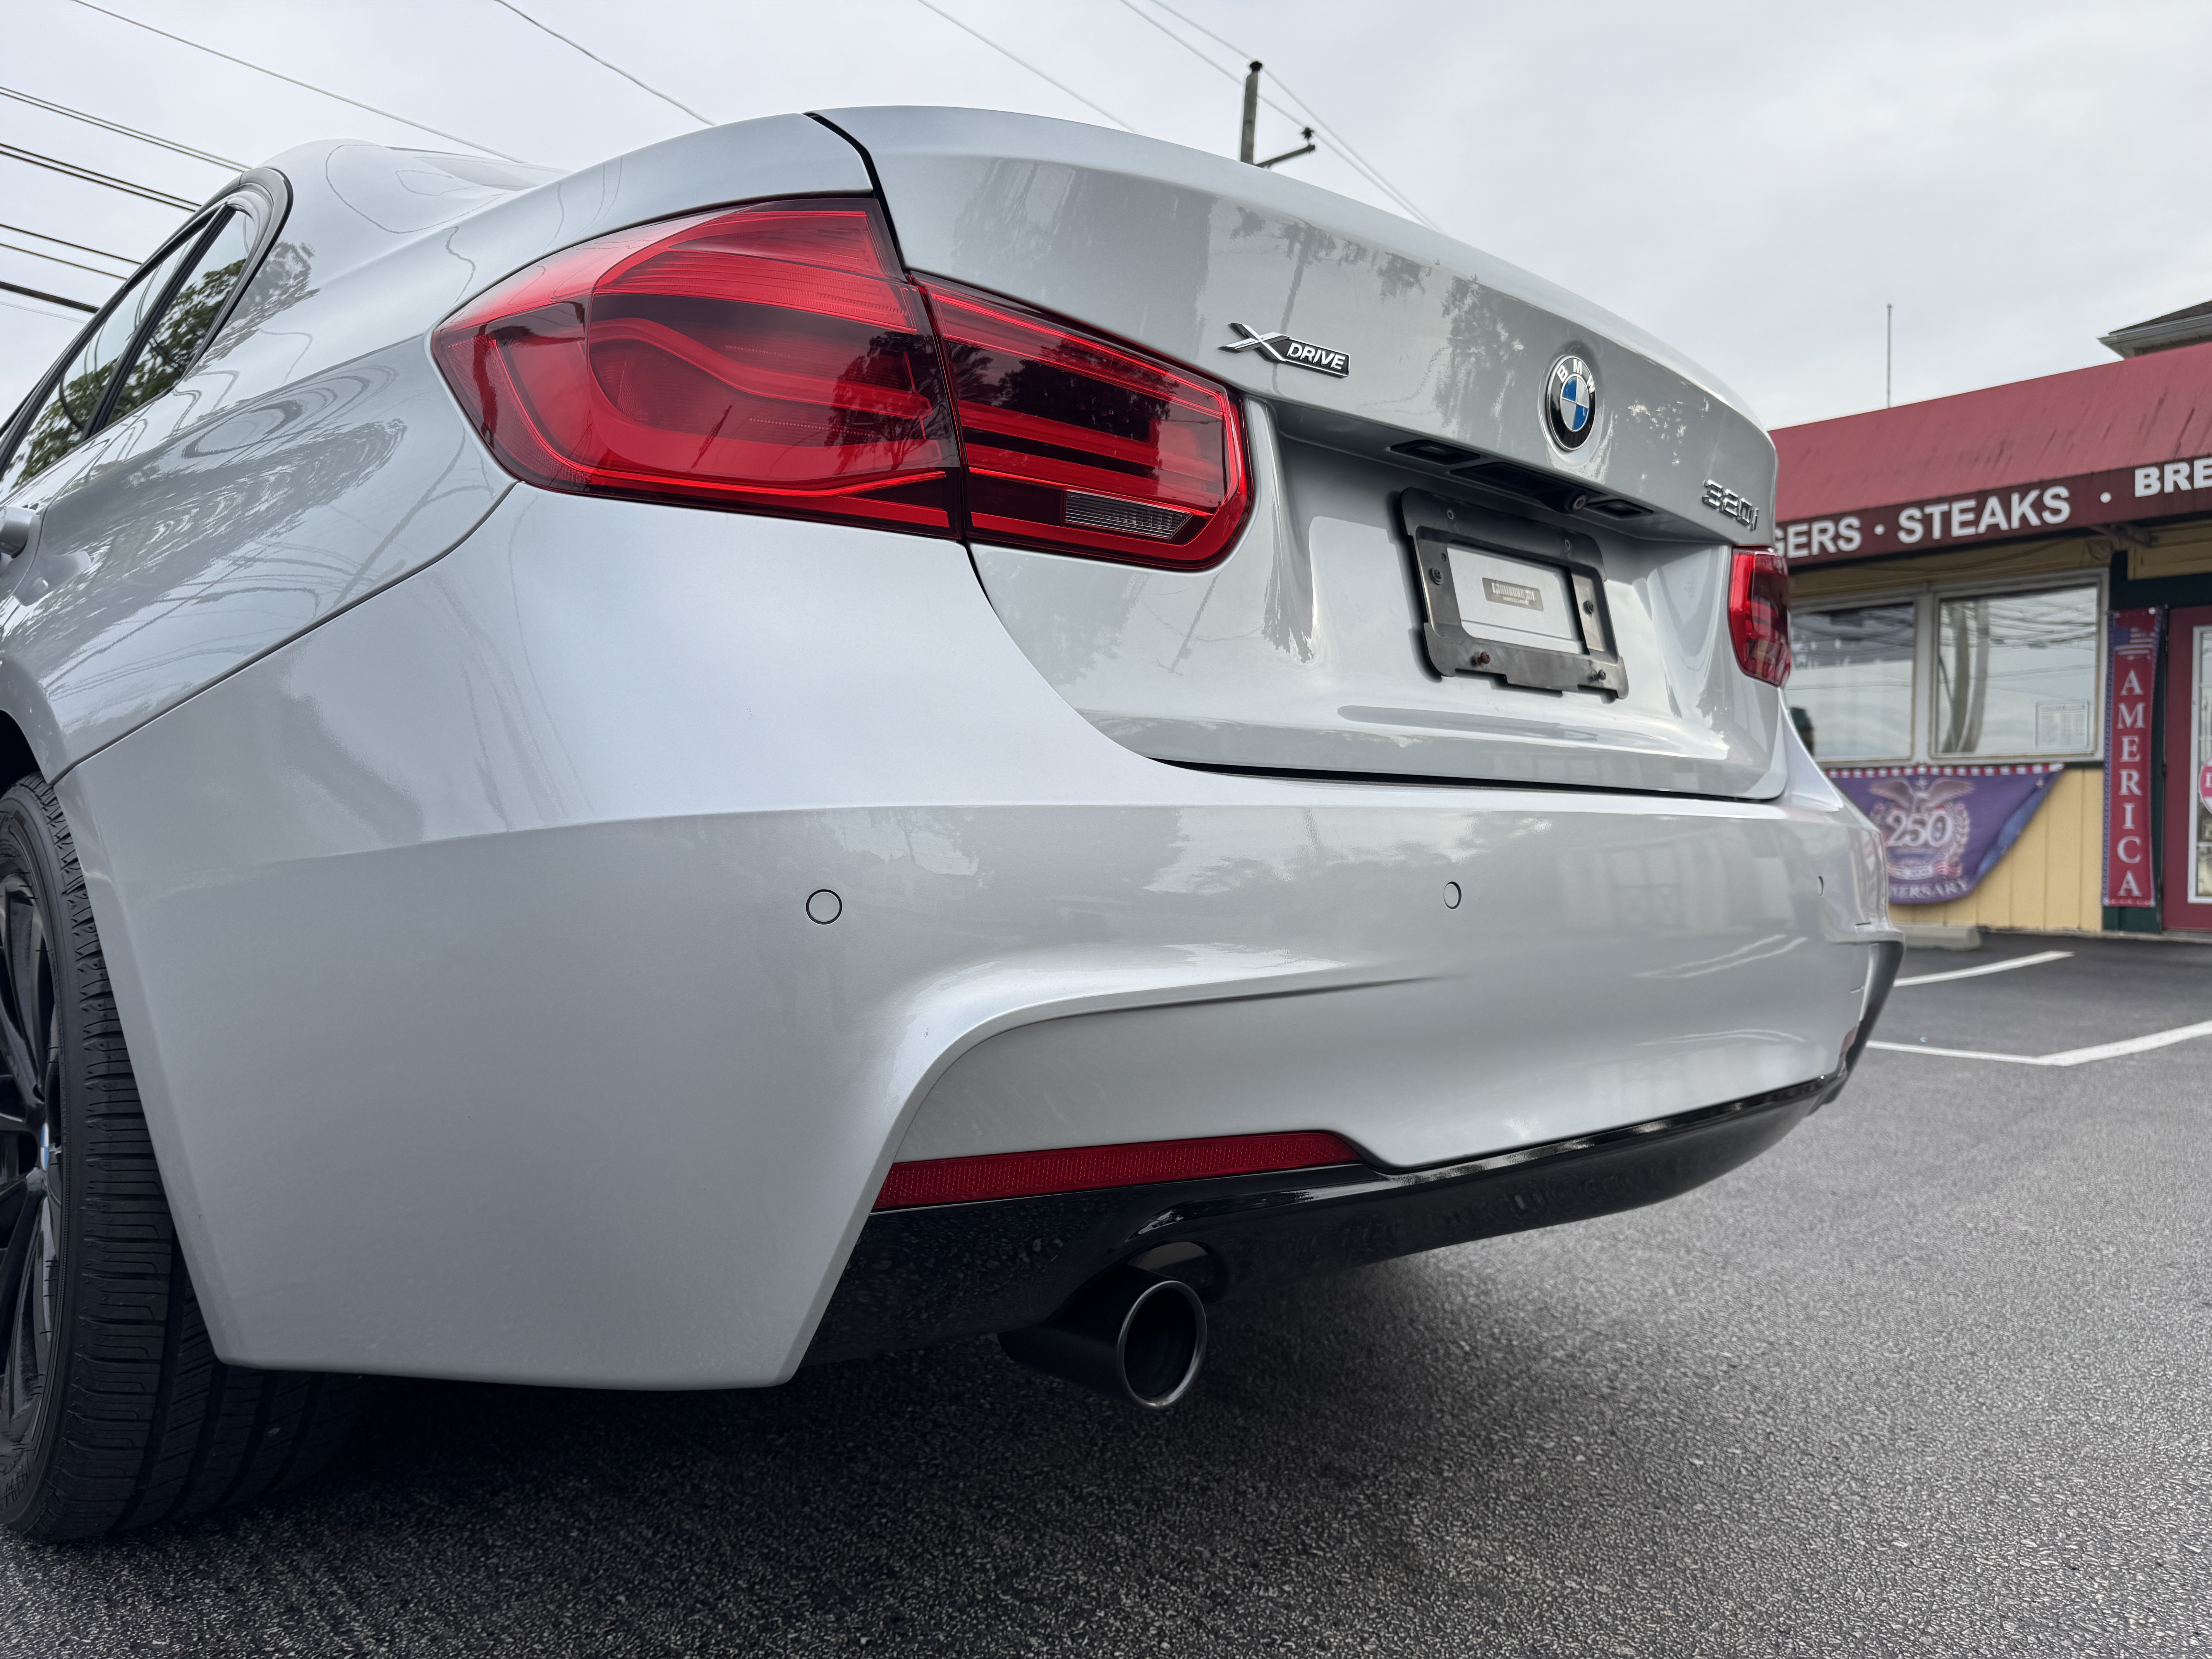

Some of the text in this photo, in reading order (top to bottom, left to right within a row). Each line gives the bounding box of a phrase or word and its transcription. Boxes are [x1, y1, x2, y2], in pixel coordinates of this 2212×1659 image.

[1557, 359, 1595, 394] BMW
[1897, 485, 2071, 544] STEAKS
[2135, 458, 2212, 498] BRE
[2116, 669, 2146, 897] AMERICA
[1886, 811, 1952, 847] 250
